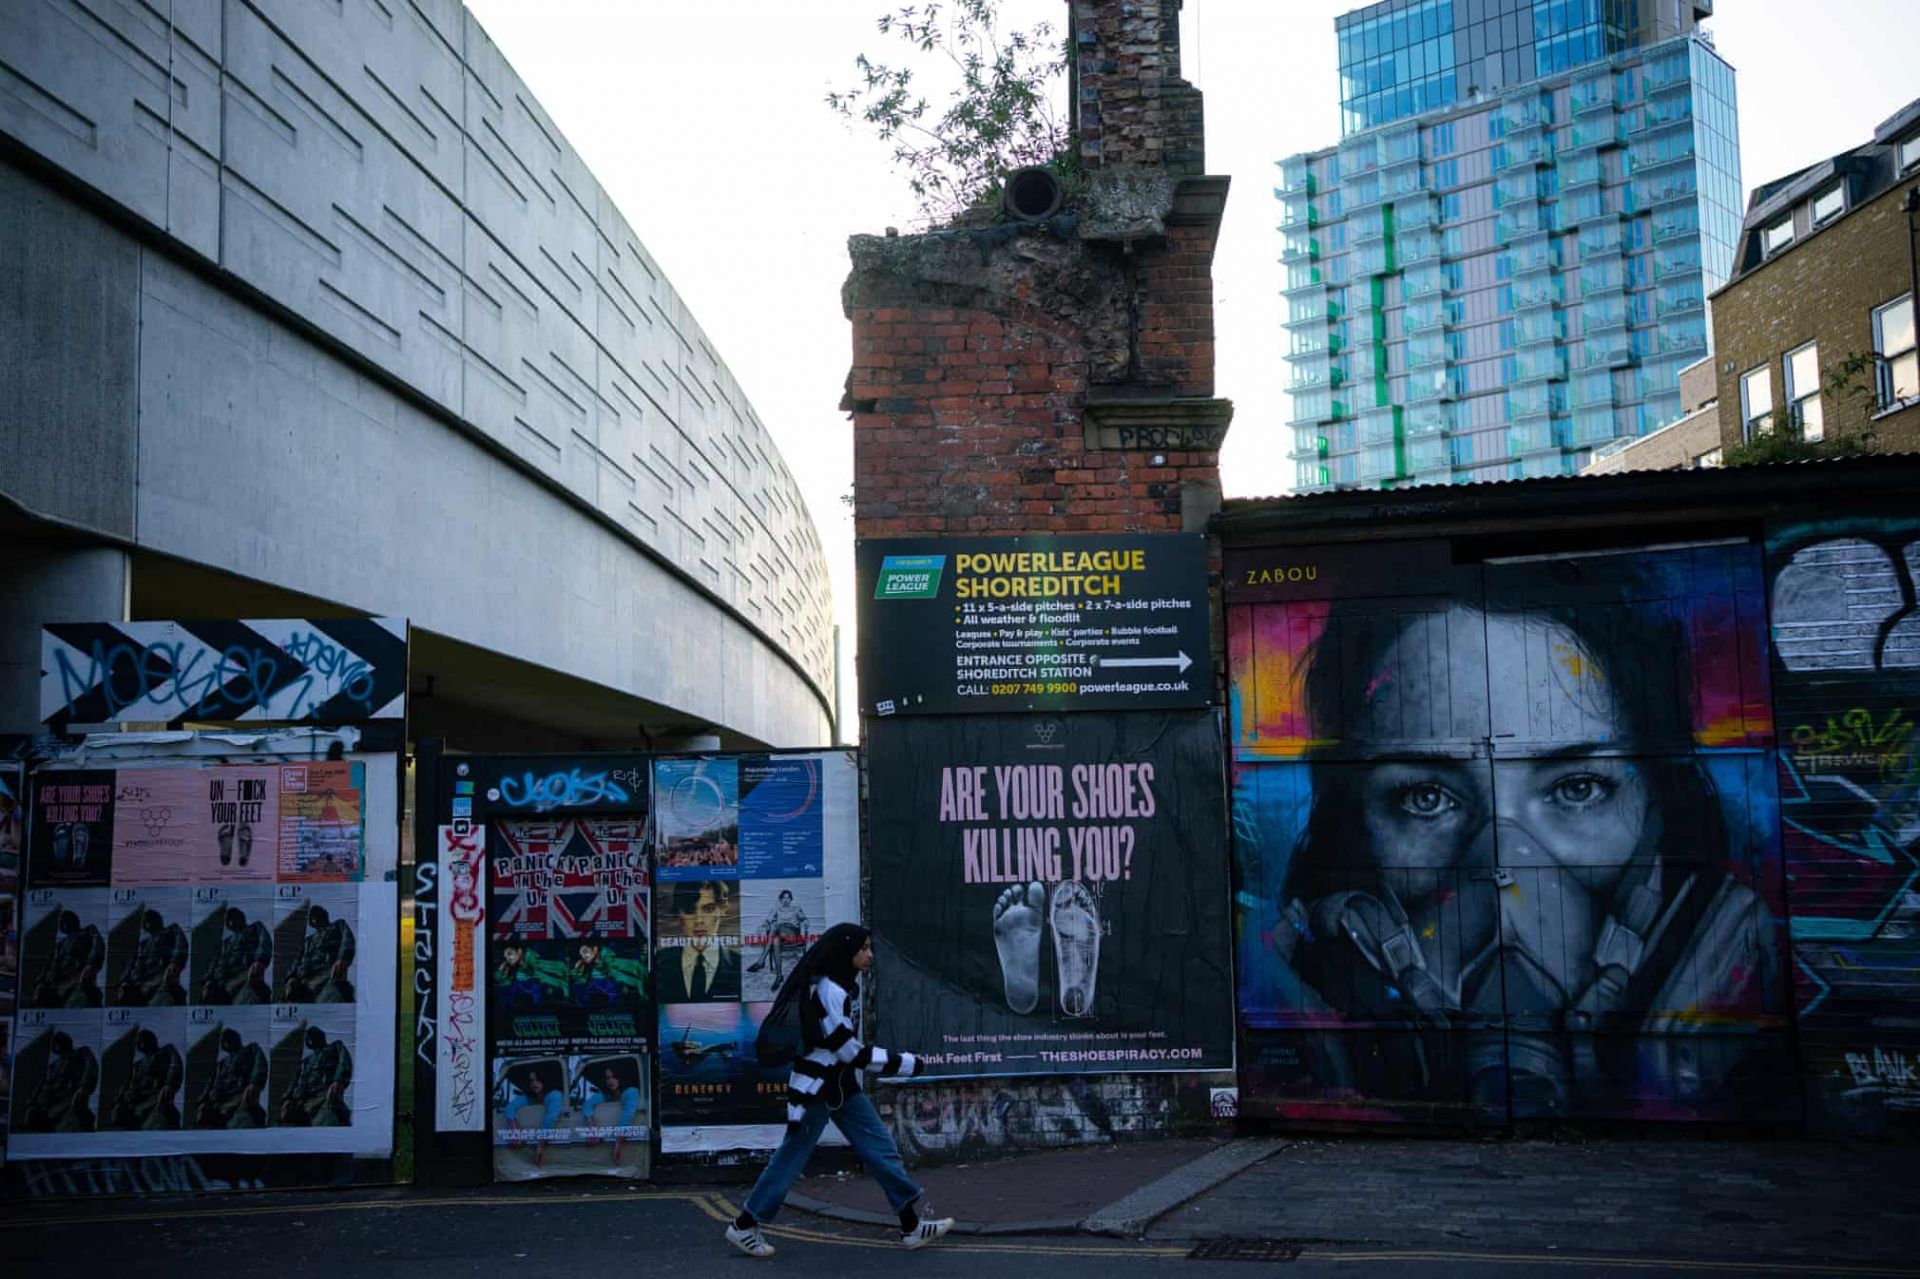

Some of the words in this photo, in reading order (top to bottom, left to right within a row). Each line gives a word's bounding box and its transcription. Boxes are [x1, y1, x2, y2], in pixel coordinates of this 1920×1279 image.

[956, 550, 1146, 574] POWERLEAGUE
[888, 574, 929, 582] POWER
[1247, 565, 1317, 585] ZABOU
[956, 575, 1121, 598] SHOREDITCH
[963, 602, 976, 613] 11
[978, 604, 985, 612] x
[987, 601, 1033, 612] 5-a-side
[1035, 601, 1075, 614] pitches
[1085, 601, 1093, 610] 2
[1095, 602, 1102, 610] x
[1104, 599, 1149, 609] 7-a-side
[1150, 598, 1191, 612] pitches
[963, 615, 978, 625] All
[980, 614, 1026, 624] weather
[1028, 613, 1037, 623] &
[1039, 613, 1080, 623] floodlit
[956, 630, 991, 639] Leagues
[999, 629, 1015, 639] Pay
[1025, 628, 1044, 638] play
[1073, 627, 1103, 637] parties
[1111, 626, 1141, 635] Bubble
[1143, 625, 1178, 635] football
[956, 640, 1001, 650] Corporate
[1002, 639, 1058, 648] tournaments
[1065, 638, 1110, 648] Corporate
[1111, 637, 1140, 646] events
[956, 655, 1022, 666] ENTRANCE
[1025, 653, 1086, 665] OPPOSITE
[956, 668, 1037, 679] SHOREDITCH
[1040, 667, 1092, 678] STATION
[957, 684, 989, 696] CALL:
[991, 683, 1019, 695] 0207
[1022, 683, 1044, 694] 749
[1047, 682, 1077, 694] 9900
[1080, 680, 1190, 695] powerleague.co.uk
[40, 785, 57, 803] ARE
[58, 785, 81, 803] YOUR
[82, 785, 111, 803] SHOES
[210, 780, 225, 800] UN
[237, 779, 267, 800] FCK
[939, 766, 989, 822] ARE
[994, 764, 1066, 820] YOUR
[1071, 762, 1157, 819] SHOES
[211, 802, 237, 823] YOUR
[239, 802, 264, 823] FEET
[963, 827, 1063, 884] KILLING
[1067, 825, 1135, 882] YOU?
[536, 872, 564, 886] the
[615, 871, 641, 886] the
[528, 890, 547, 906] UK
[607, 889, 627, 904] UK
[942, 1034, 958, 1042] The
[960, 1034, 975, 1042] last
[976, 1034, 997, 1044] thing
[998, 1033, 1012, 1041] the
[1033, 1032, 1067, 1042] industry
[1069, 1032, 1094, 1040] thinks
[1096, 1032, 1118, 1040] about
[1129, 1032, 1147, 1040] your
[945, 1052, 973, 1064] Feet
[974, 1051, 1003, 1063] First
